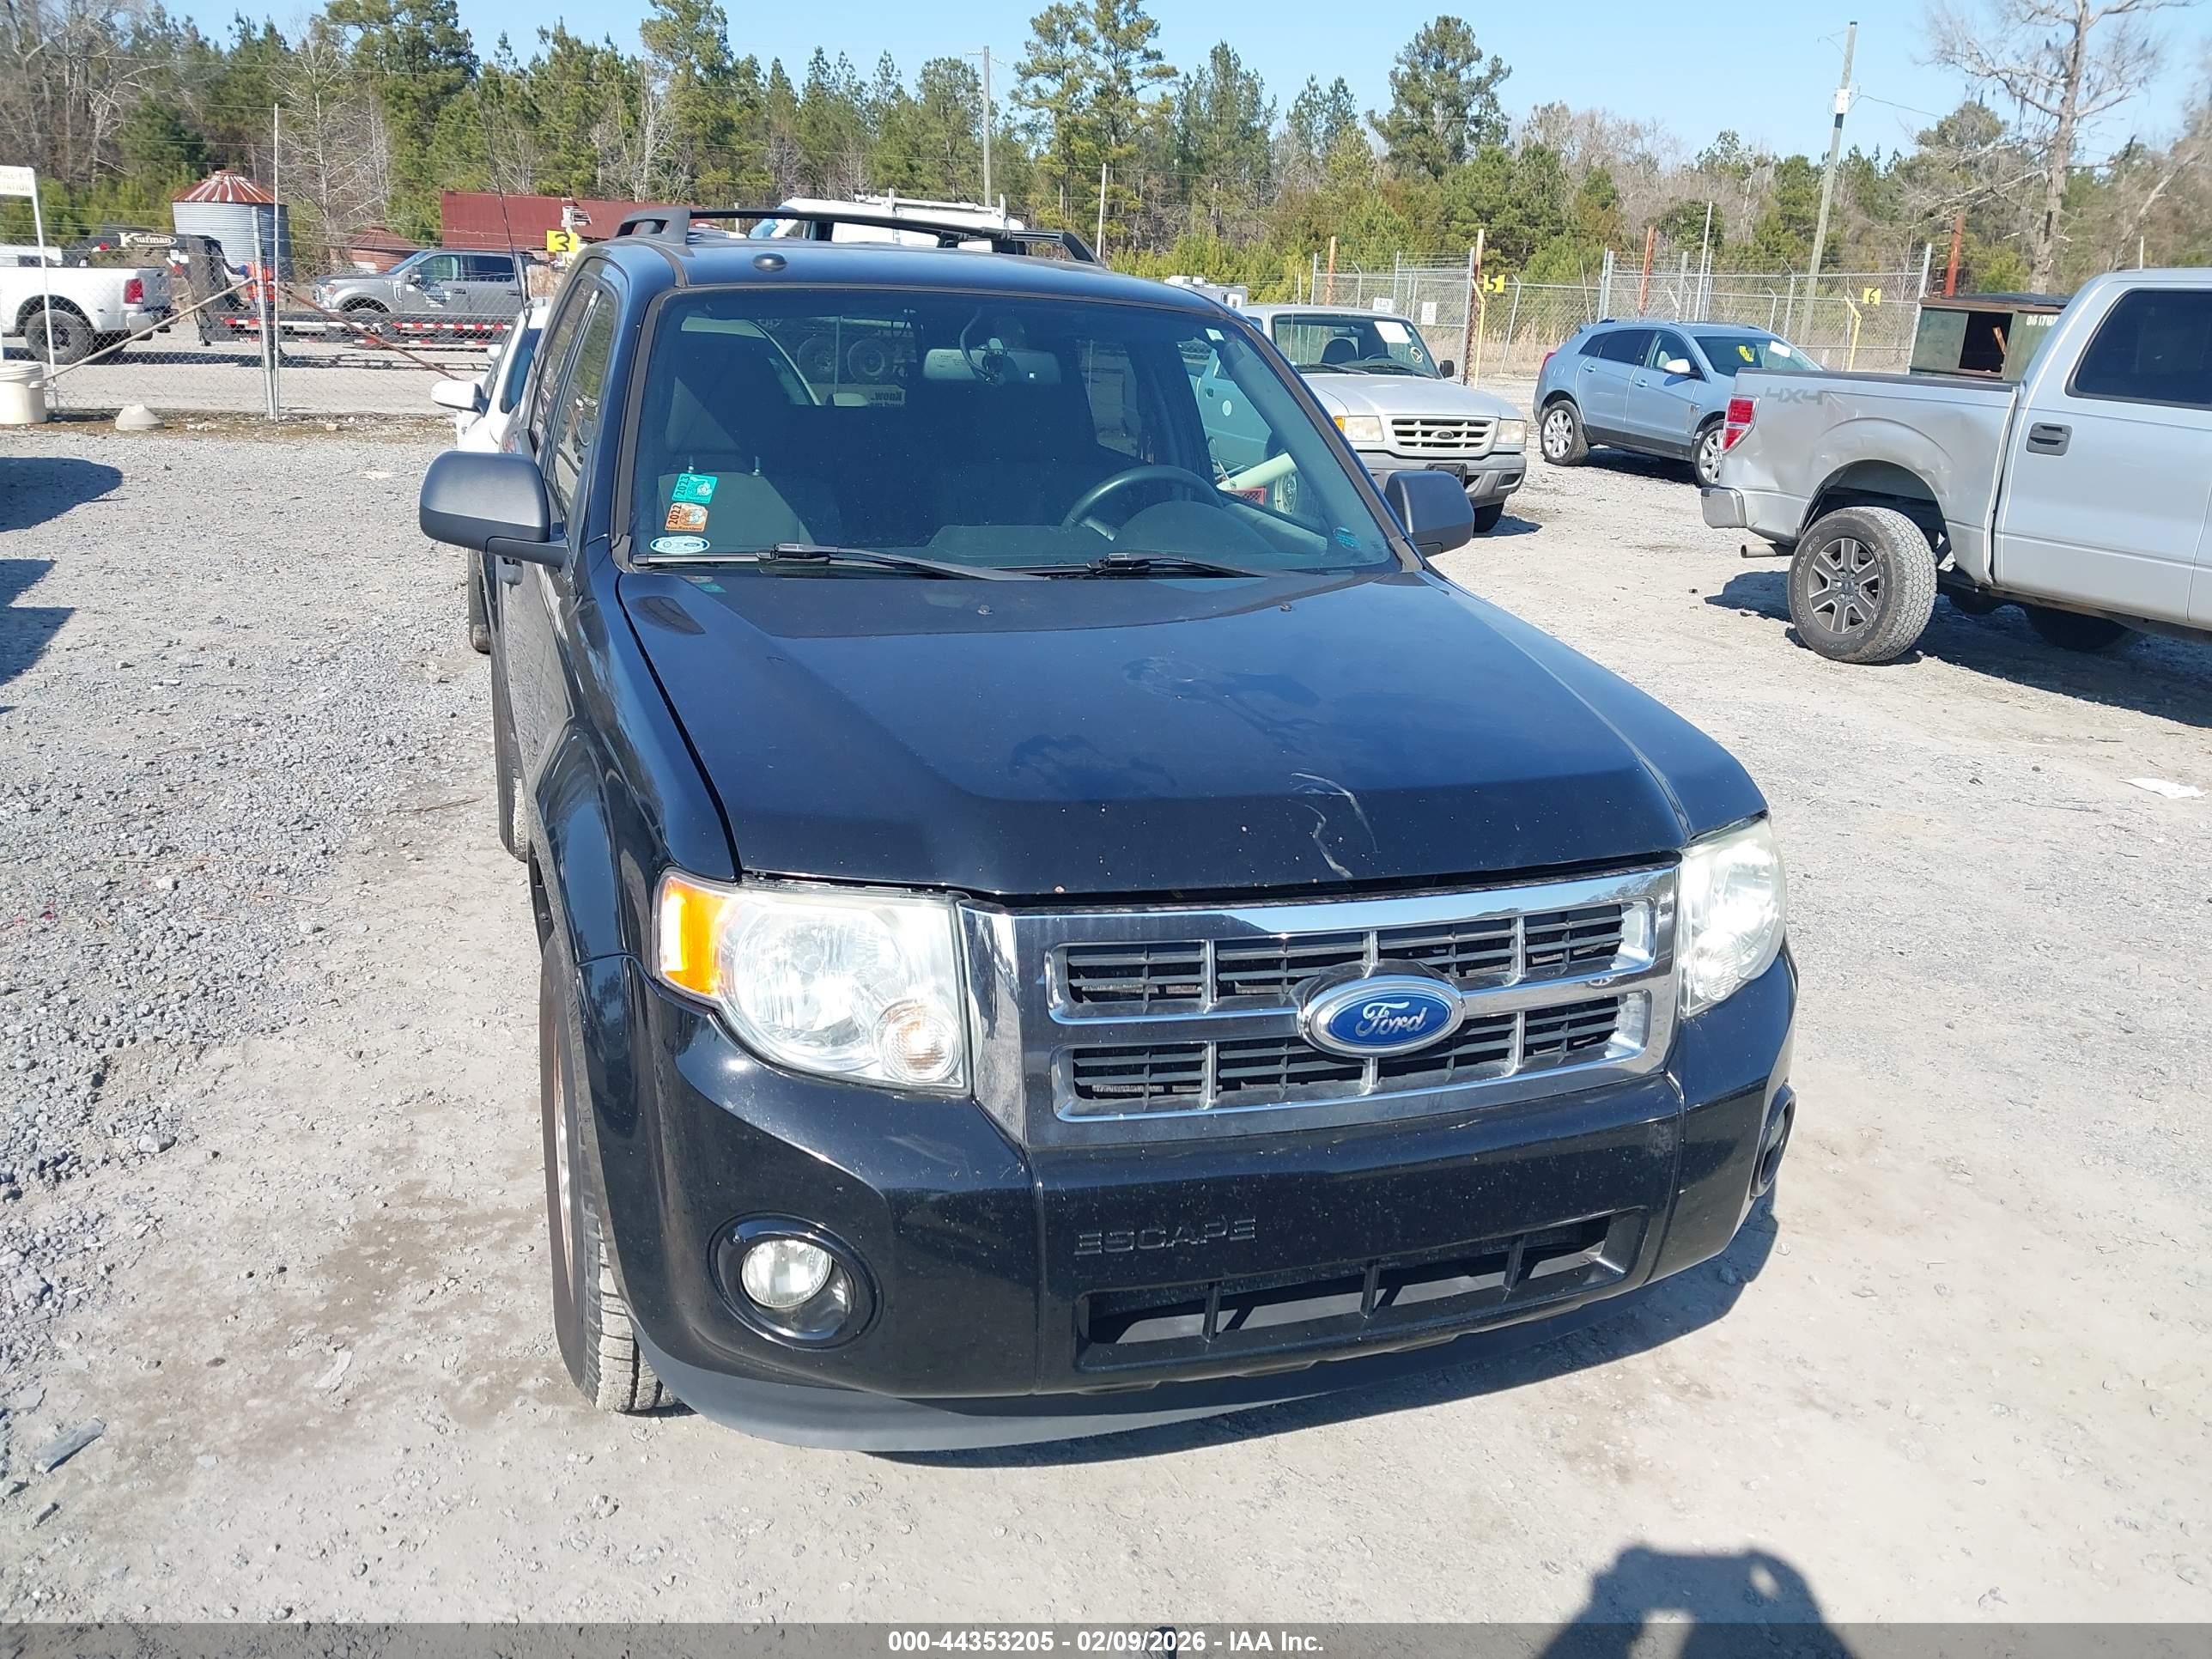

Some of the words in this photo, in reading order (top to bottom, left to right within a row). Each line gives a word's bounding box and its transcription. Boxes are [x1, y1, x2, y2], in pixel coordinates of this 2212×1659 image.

[118, 232, 172, 247] Kaufman
[555, 233, 571, 252] 3
[1486, 274, 1499, 292] 5
[1868, 288, 1878, 304] 6
[675, 476, 690, 495] 2023
[667, 505, 683, 525] 2022
[1355, 1000, 1427, 1037] Ford
[1073, 1216, 1257, 1255] ESCAPE
